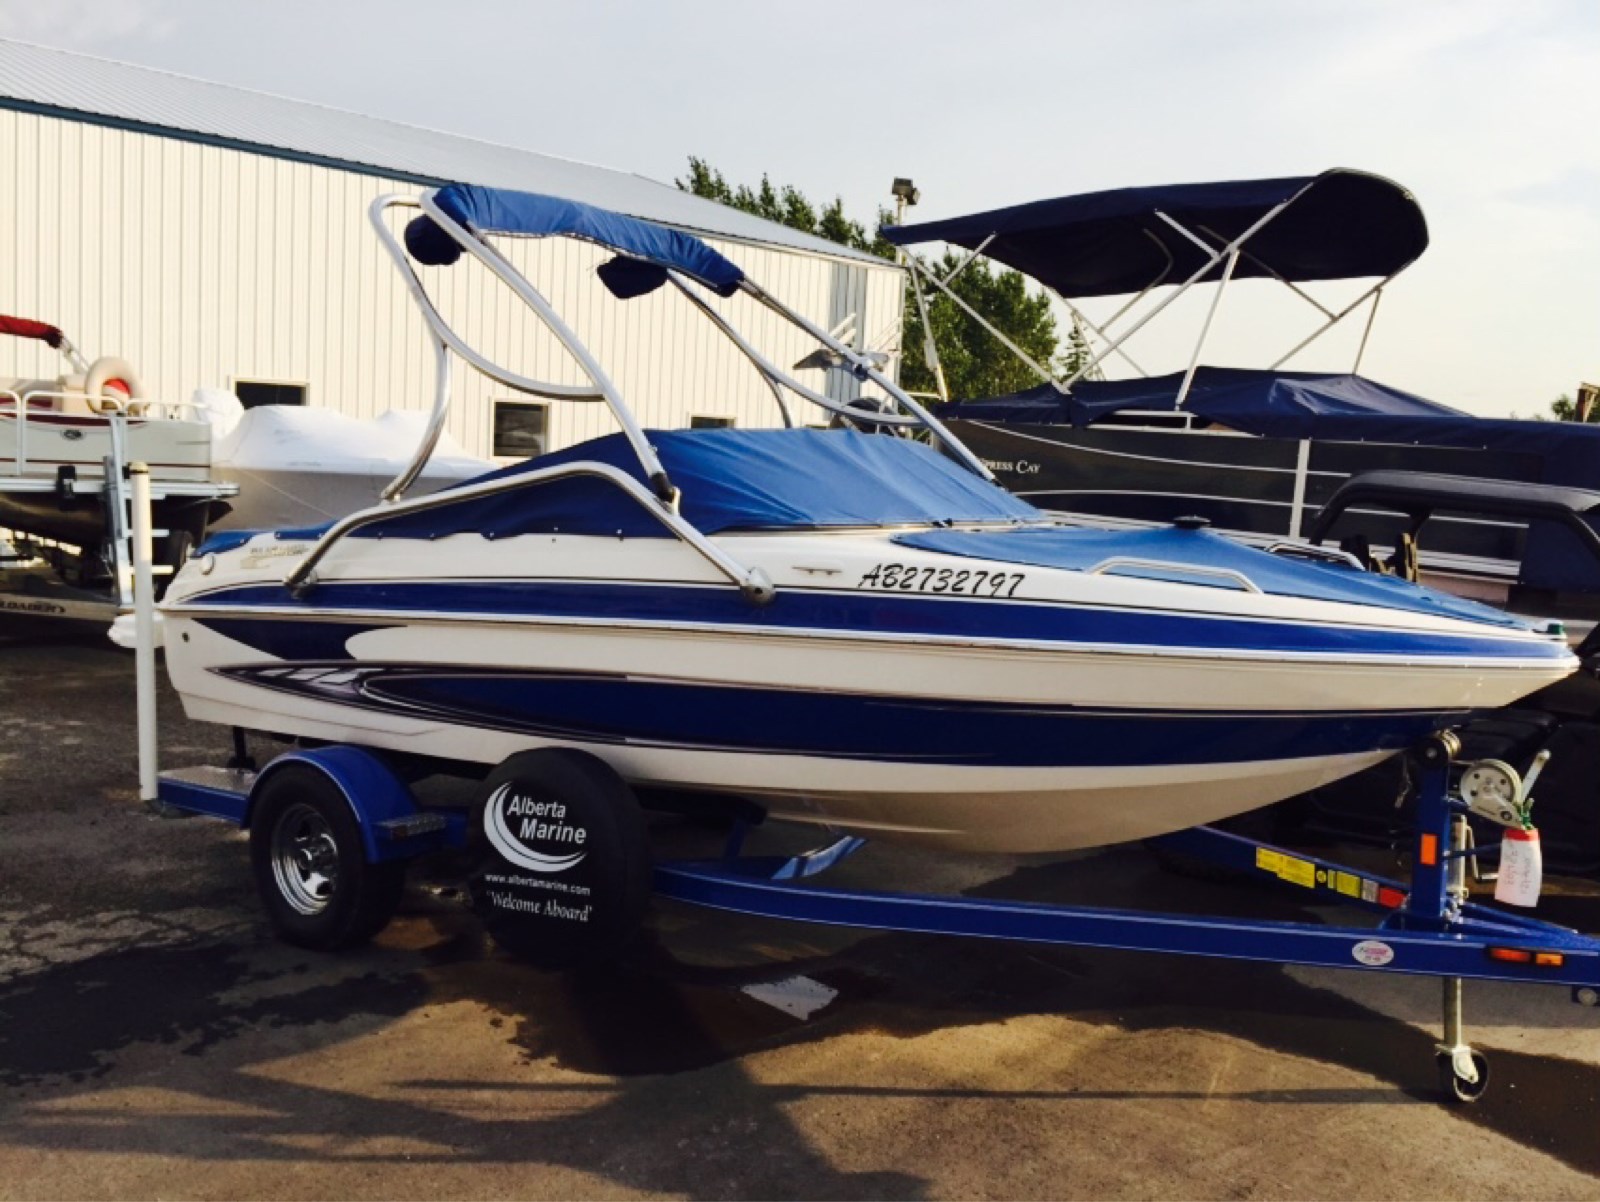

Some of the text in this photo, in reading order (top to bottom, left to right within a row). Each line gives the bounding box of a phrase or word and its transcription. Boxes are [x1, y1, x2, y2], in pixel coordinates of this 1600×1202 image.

[858, 563, 1025, 598] AB2732797
[507, 795, 566, 818] Alberta
[519, 817, 587, 844] Marine
[484, 874, 591, 896] www.albertamarine.com
